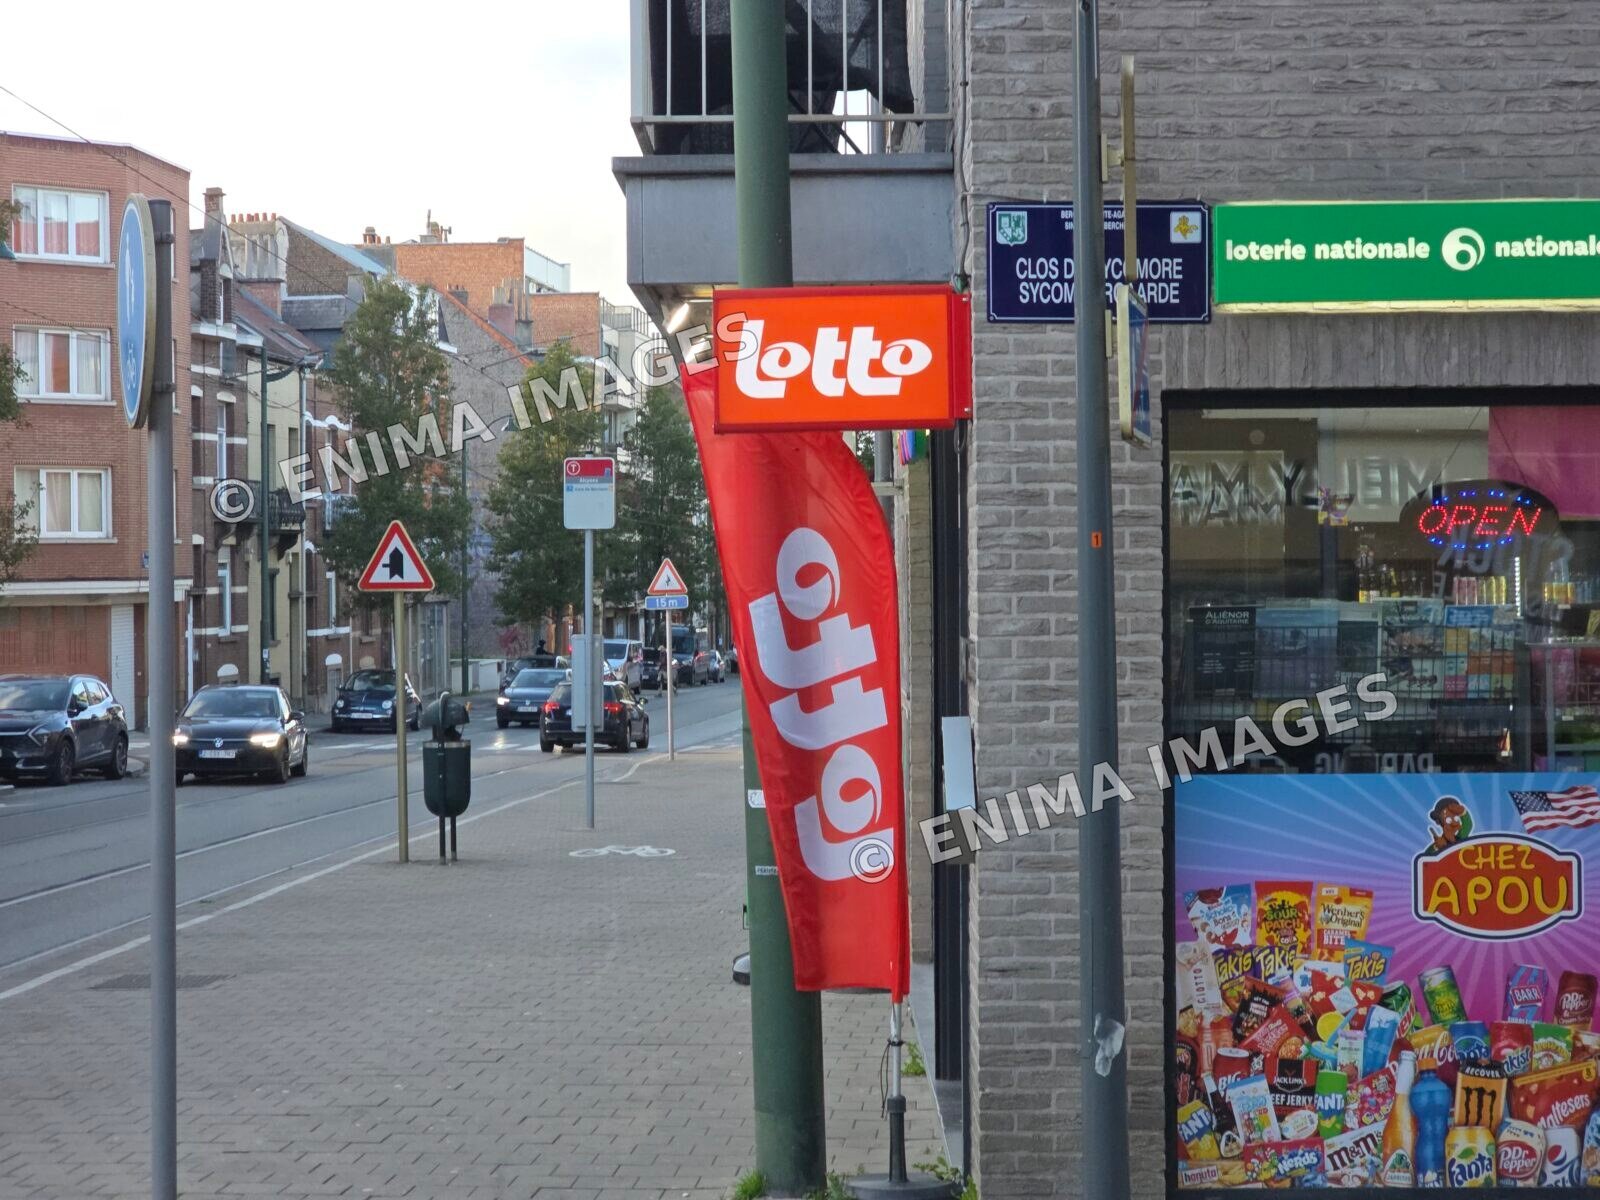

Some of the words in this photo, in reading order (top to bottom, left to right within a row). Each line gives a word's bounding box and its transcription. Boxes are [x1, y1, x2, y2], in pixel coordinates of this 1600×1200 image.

[1226, 238, 1307, 261] loterie
[1315, 237, 1430, 260] nationale
[1016, 258, 1059, 279] CLOS
[1104, 258, 1183, 279] YCMORE
[1418, 505, 1542, 535] OPEN
[1459, 845, 1535, 869] CHEZ
[1427, 876, 1567, 915] APOU
[1265, 908, 1299, 920] SOUR
[1324, 935, 1345, 945] BITE
[1215, 951, 1252, 982] Takis
[1256, 947, 1296, 981] Takis
[1346, 956, 1386, 979] Takis
[1514, 989, 1540, 1001] BARR
[1465, 1066, 1500, 1078] RECOVER
[1272, 1094, 1286, 1105] EEF
[1286, 1095, 1313, 1106] JERKY
